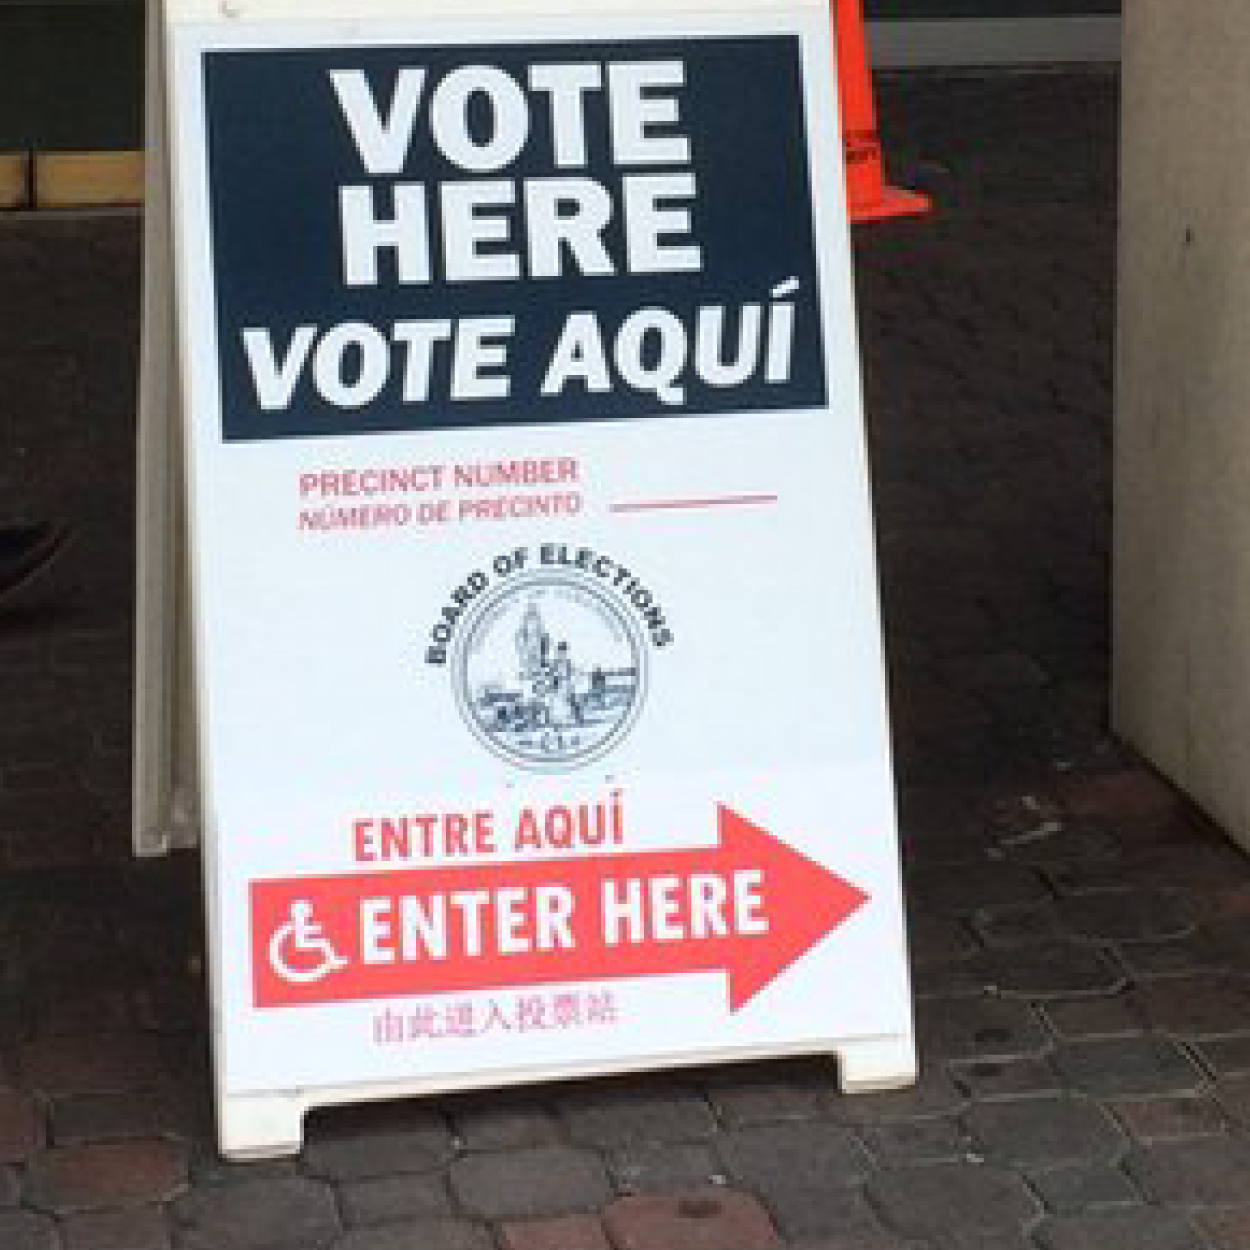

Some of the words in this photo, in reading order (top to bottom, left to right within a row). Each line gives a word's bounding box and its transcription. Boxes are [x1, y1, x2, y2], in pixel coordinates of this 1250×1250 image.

[329, 60, 692, 174] VOTE
[337, 172, 704, 286] HERE
[242, 317, 515, 411] VOTE
[540, 276, 800, 406] AQUÍ
[298, 465, 443, 497] PRECINCT
[454, 456, 579, 488] NUMBER
[418, 499, 452, 525] DE
[458, 493, 582, 521] PRECINTO
[425, 571, 489, 665] BOARD
[492, 547, 529, 578] OF
[540, 542, 675, 649] ELECTIONS
[352, 813, 496, 862] ENTRE
[513, 788, 625, 850] AQUÍ
[360, 884, 576, 965] ENTER
[602, 869, 770, 946] HERE
